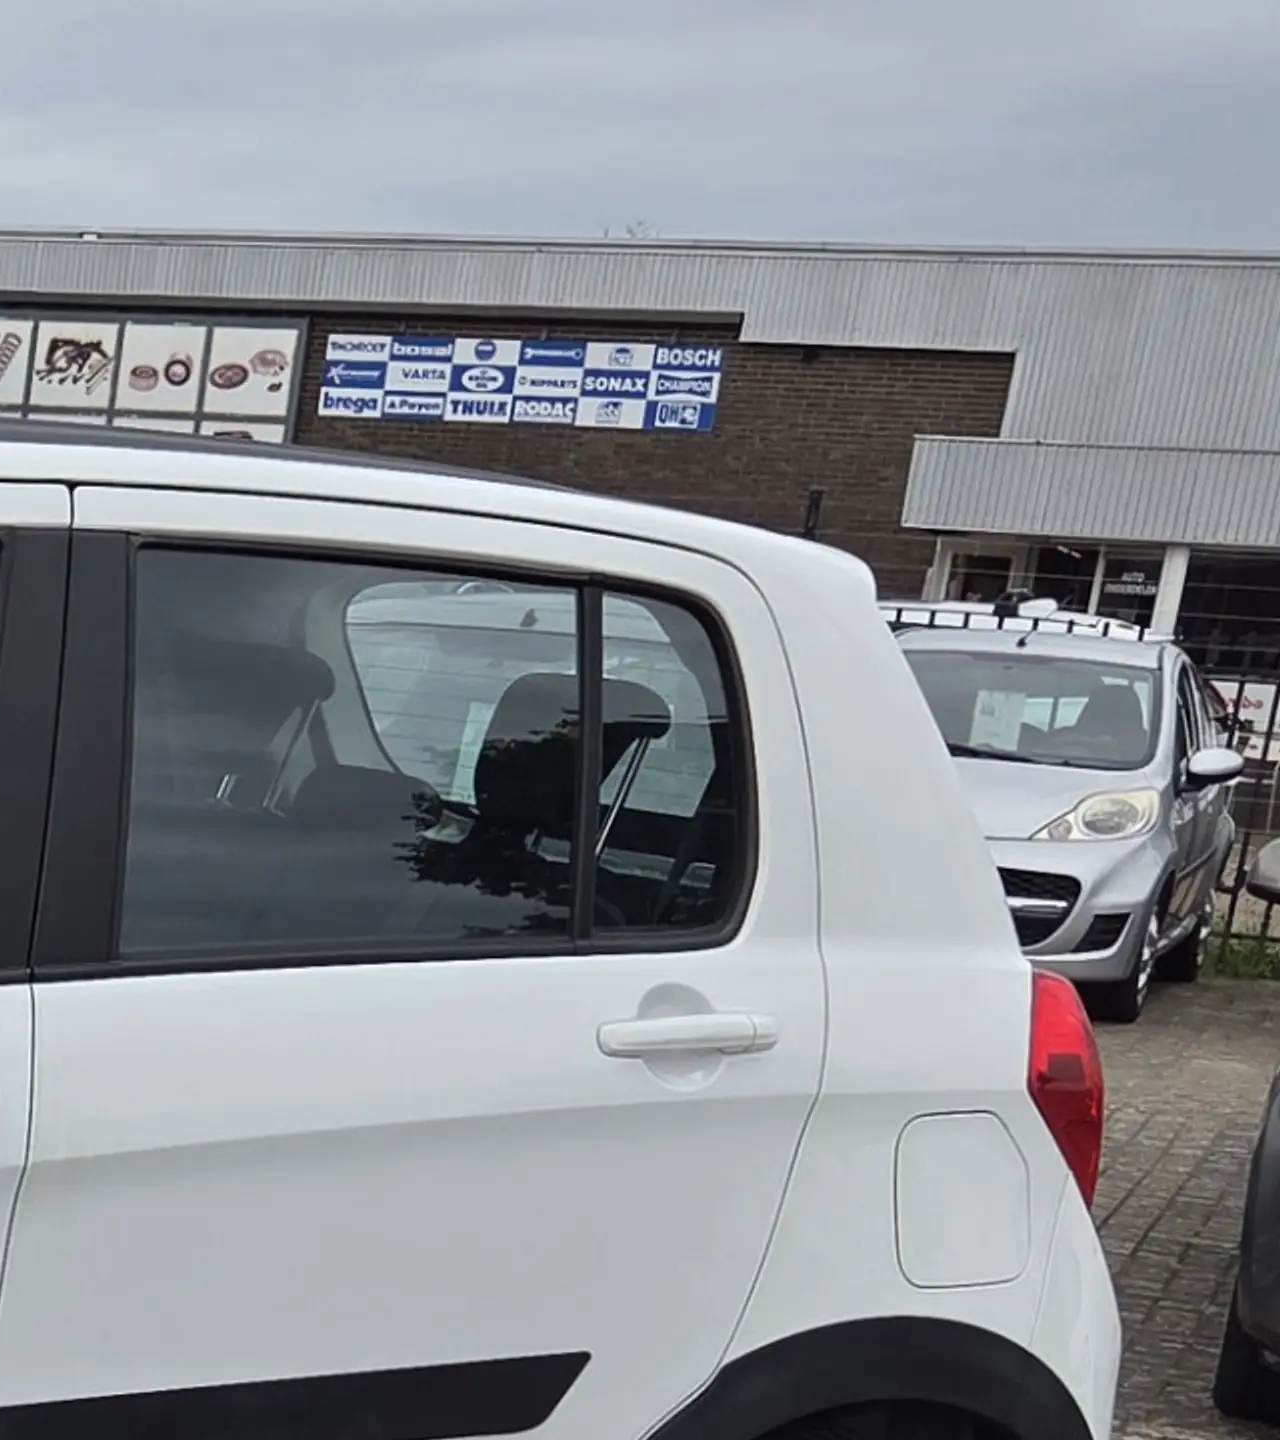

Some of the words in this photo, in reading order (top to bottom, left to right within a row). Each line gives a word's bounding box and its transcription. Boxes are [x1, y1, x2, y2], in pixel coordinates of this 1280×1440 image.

[656, 347, 721, 367] BOSCH
[402, 368, 446, 380] VARTA
[584, 376, 646, 392] SONAX
[658, 379, 711, 392] CHAMPION
[323, 391, 378, 413] brega
[450, 400, 508, 416] THULE
[514, 400, 575, 416] RODAC
